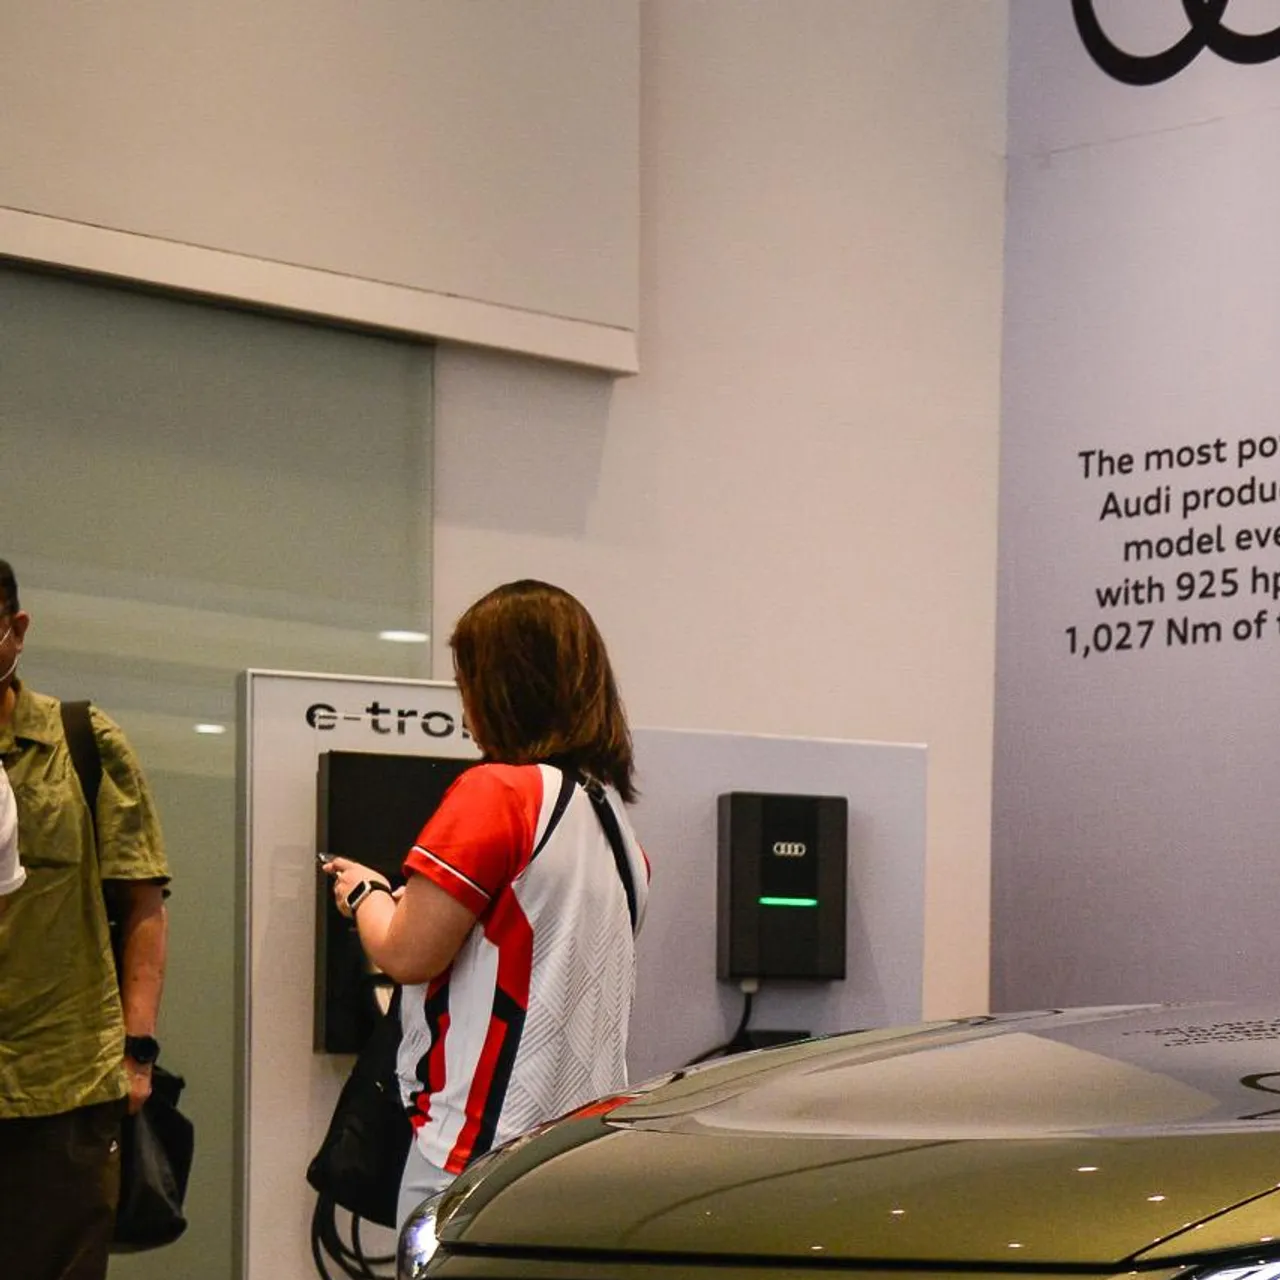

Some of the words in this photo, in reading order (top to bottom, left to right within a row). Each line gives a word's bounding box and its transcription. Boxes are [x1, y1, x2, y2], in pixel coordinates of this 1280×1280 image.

[1078, 450, 1134, 478] The
[1144, 438, 1227, 472] most
[1099, 486, 1171, 520] Audi
[1123, 524, 1226, 562] model
[1095, 575, 1164, 608] with
[1175, 567, 1239, 602] 925
[1064, 619, 1156, 658] 1,027
[1166, 616, 1222, 647] Nm
[1232, 609, 1268, 641] of
